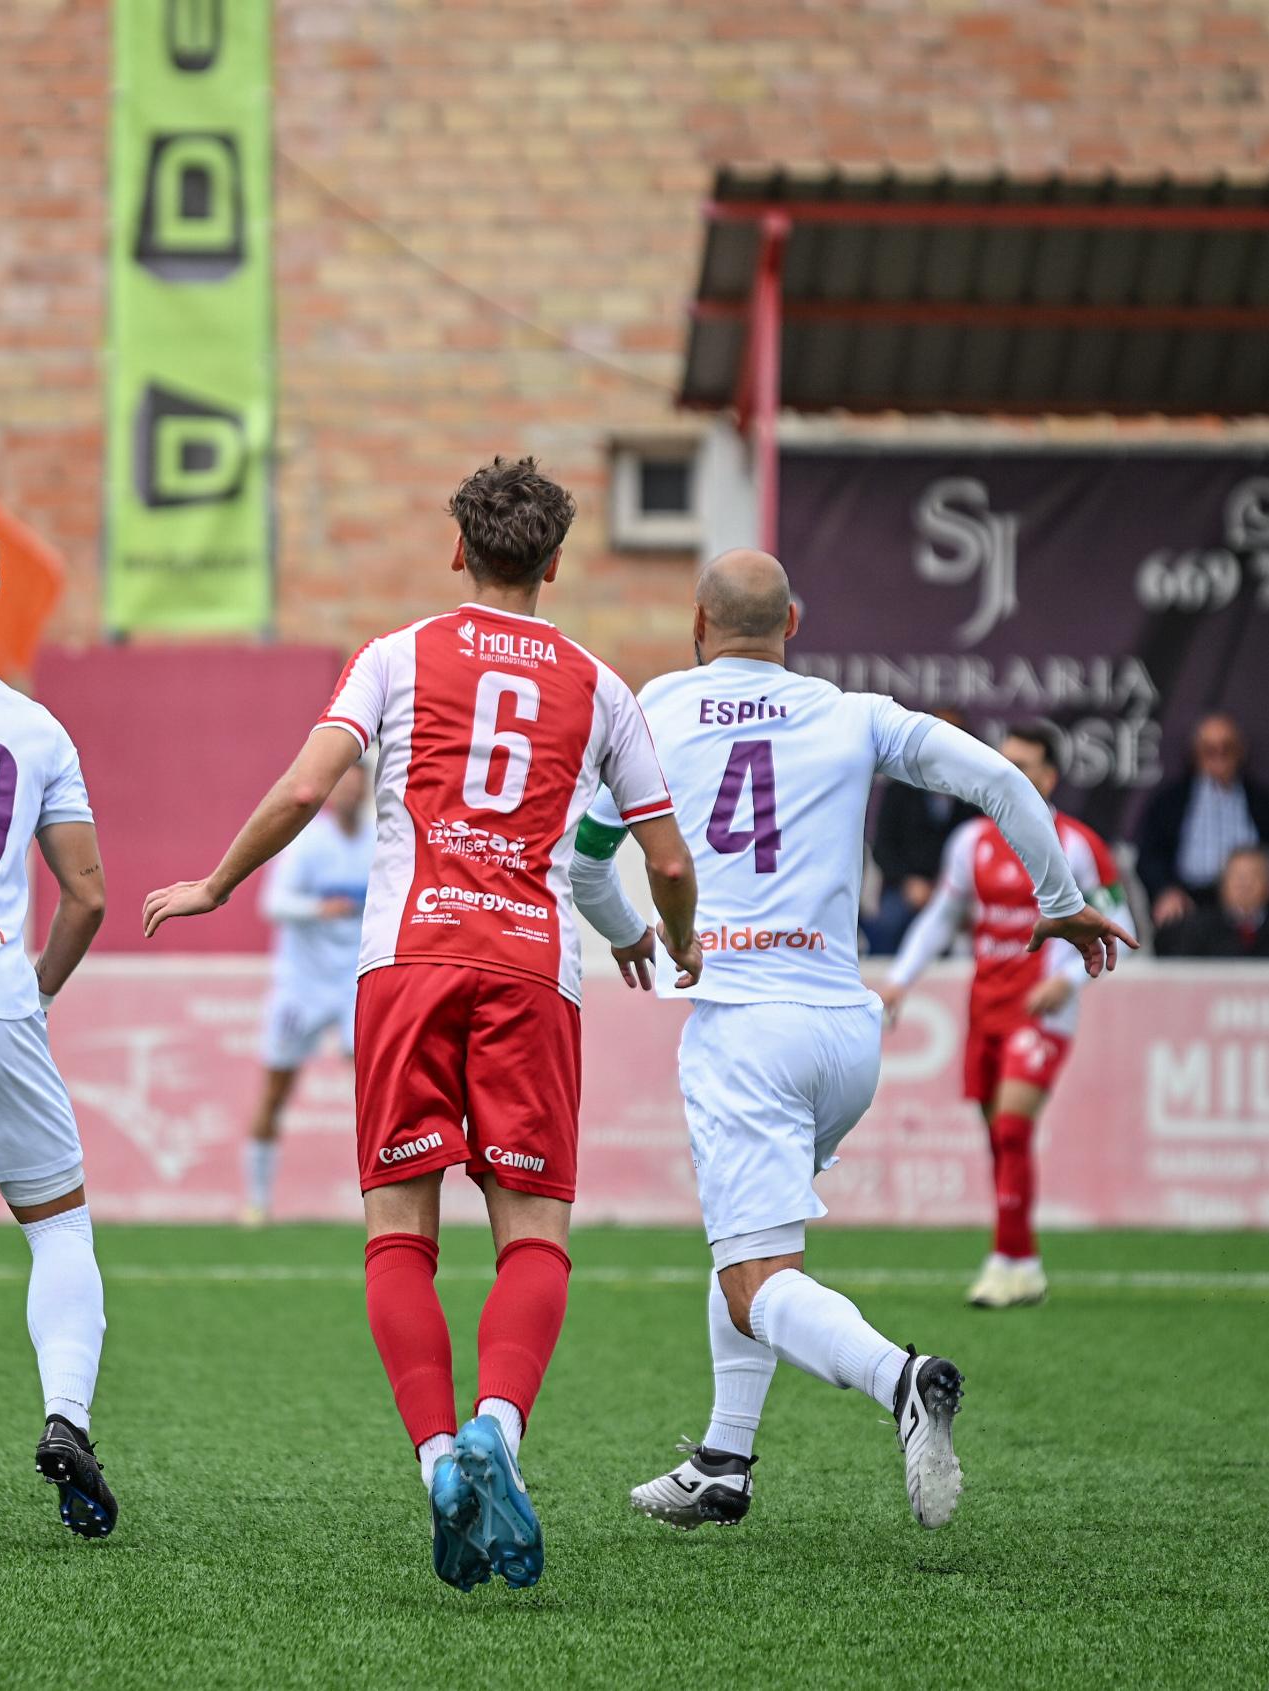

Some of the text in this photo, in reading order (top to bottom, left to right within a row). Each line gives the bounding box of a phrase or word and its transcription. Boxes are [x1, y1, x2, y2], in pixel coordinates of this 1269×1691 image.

[479, 632, 557, 664] MOLERA
[463, 671, 540, 814] 6
[705, 739, 783, 874] 4
[439, 886, 548, 920] energycasa
[699, 926, 826, 951] alderón
[378, 1131, 443, 1164] Canon
[484, 1145, 545, 1172] Canon
